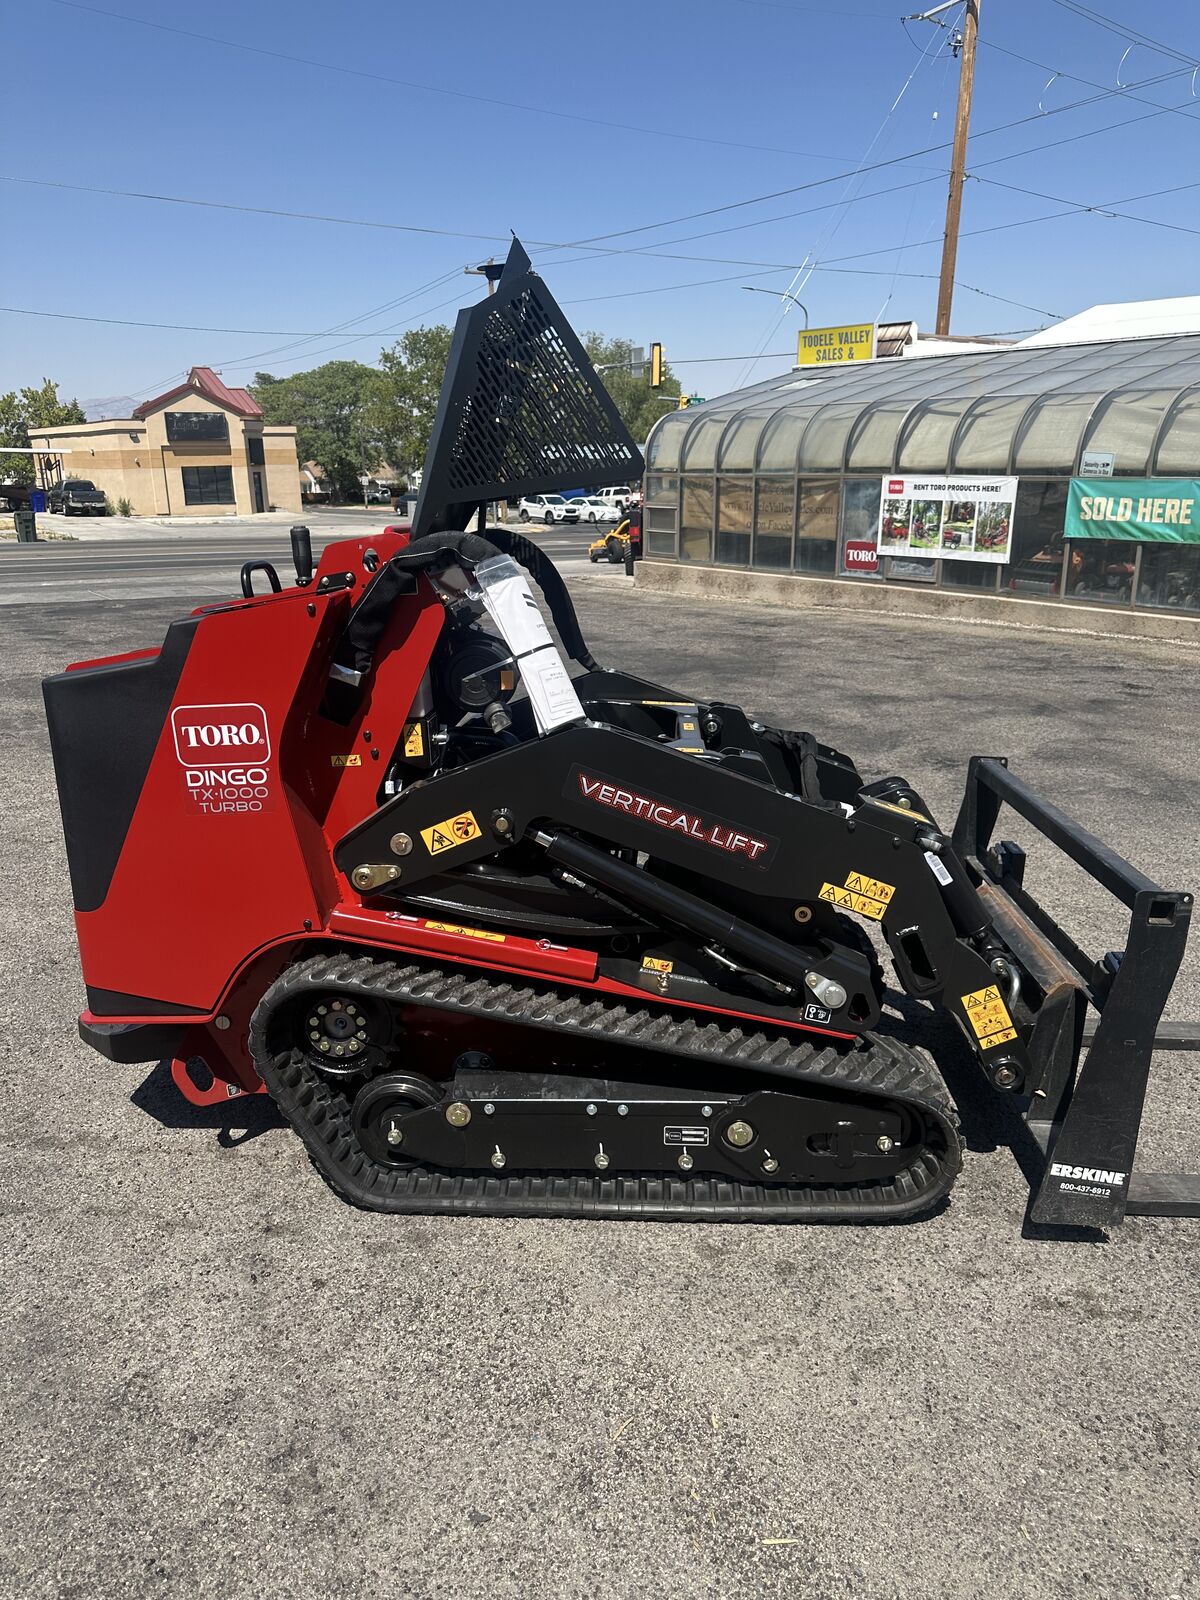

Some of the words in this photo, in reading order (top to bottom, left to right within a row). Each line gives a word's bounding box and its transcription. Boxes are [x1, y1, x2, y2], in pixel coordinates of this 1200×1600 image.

[803, 333, 834, 348] TOOELE
[838, 329, 870, 345] VALLEY
[816, 348, 843, 361] SALES
[847, 347, 855, 360] &
[930, 484, 947, 492] TORO
[947, 485, 981, 493] PRODUCTS
[982, 485, 1001, 493] HERE!
[1080, 496, 1133, 522] SOLD
[1136, 498, 1194, 525] HERE
[847, 549, 877, 563] TORO
[181, 723, 261, 747] TORO
[186, 768, 268, 787] DINGO
[199, 801, 263, 813] TURBO
[580, 776, 704, 838] VERTICAL
[711, 827, 765, 858] LIFT
[1050, 1164, 1125, 1185] ERSKINE
